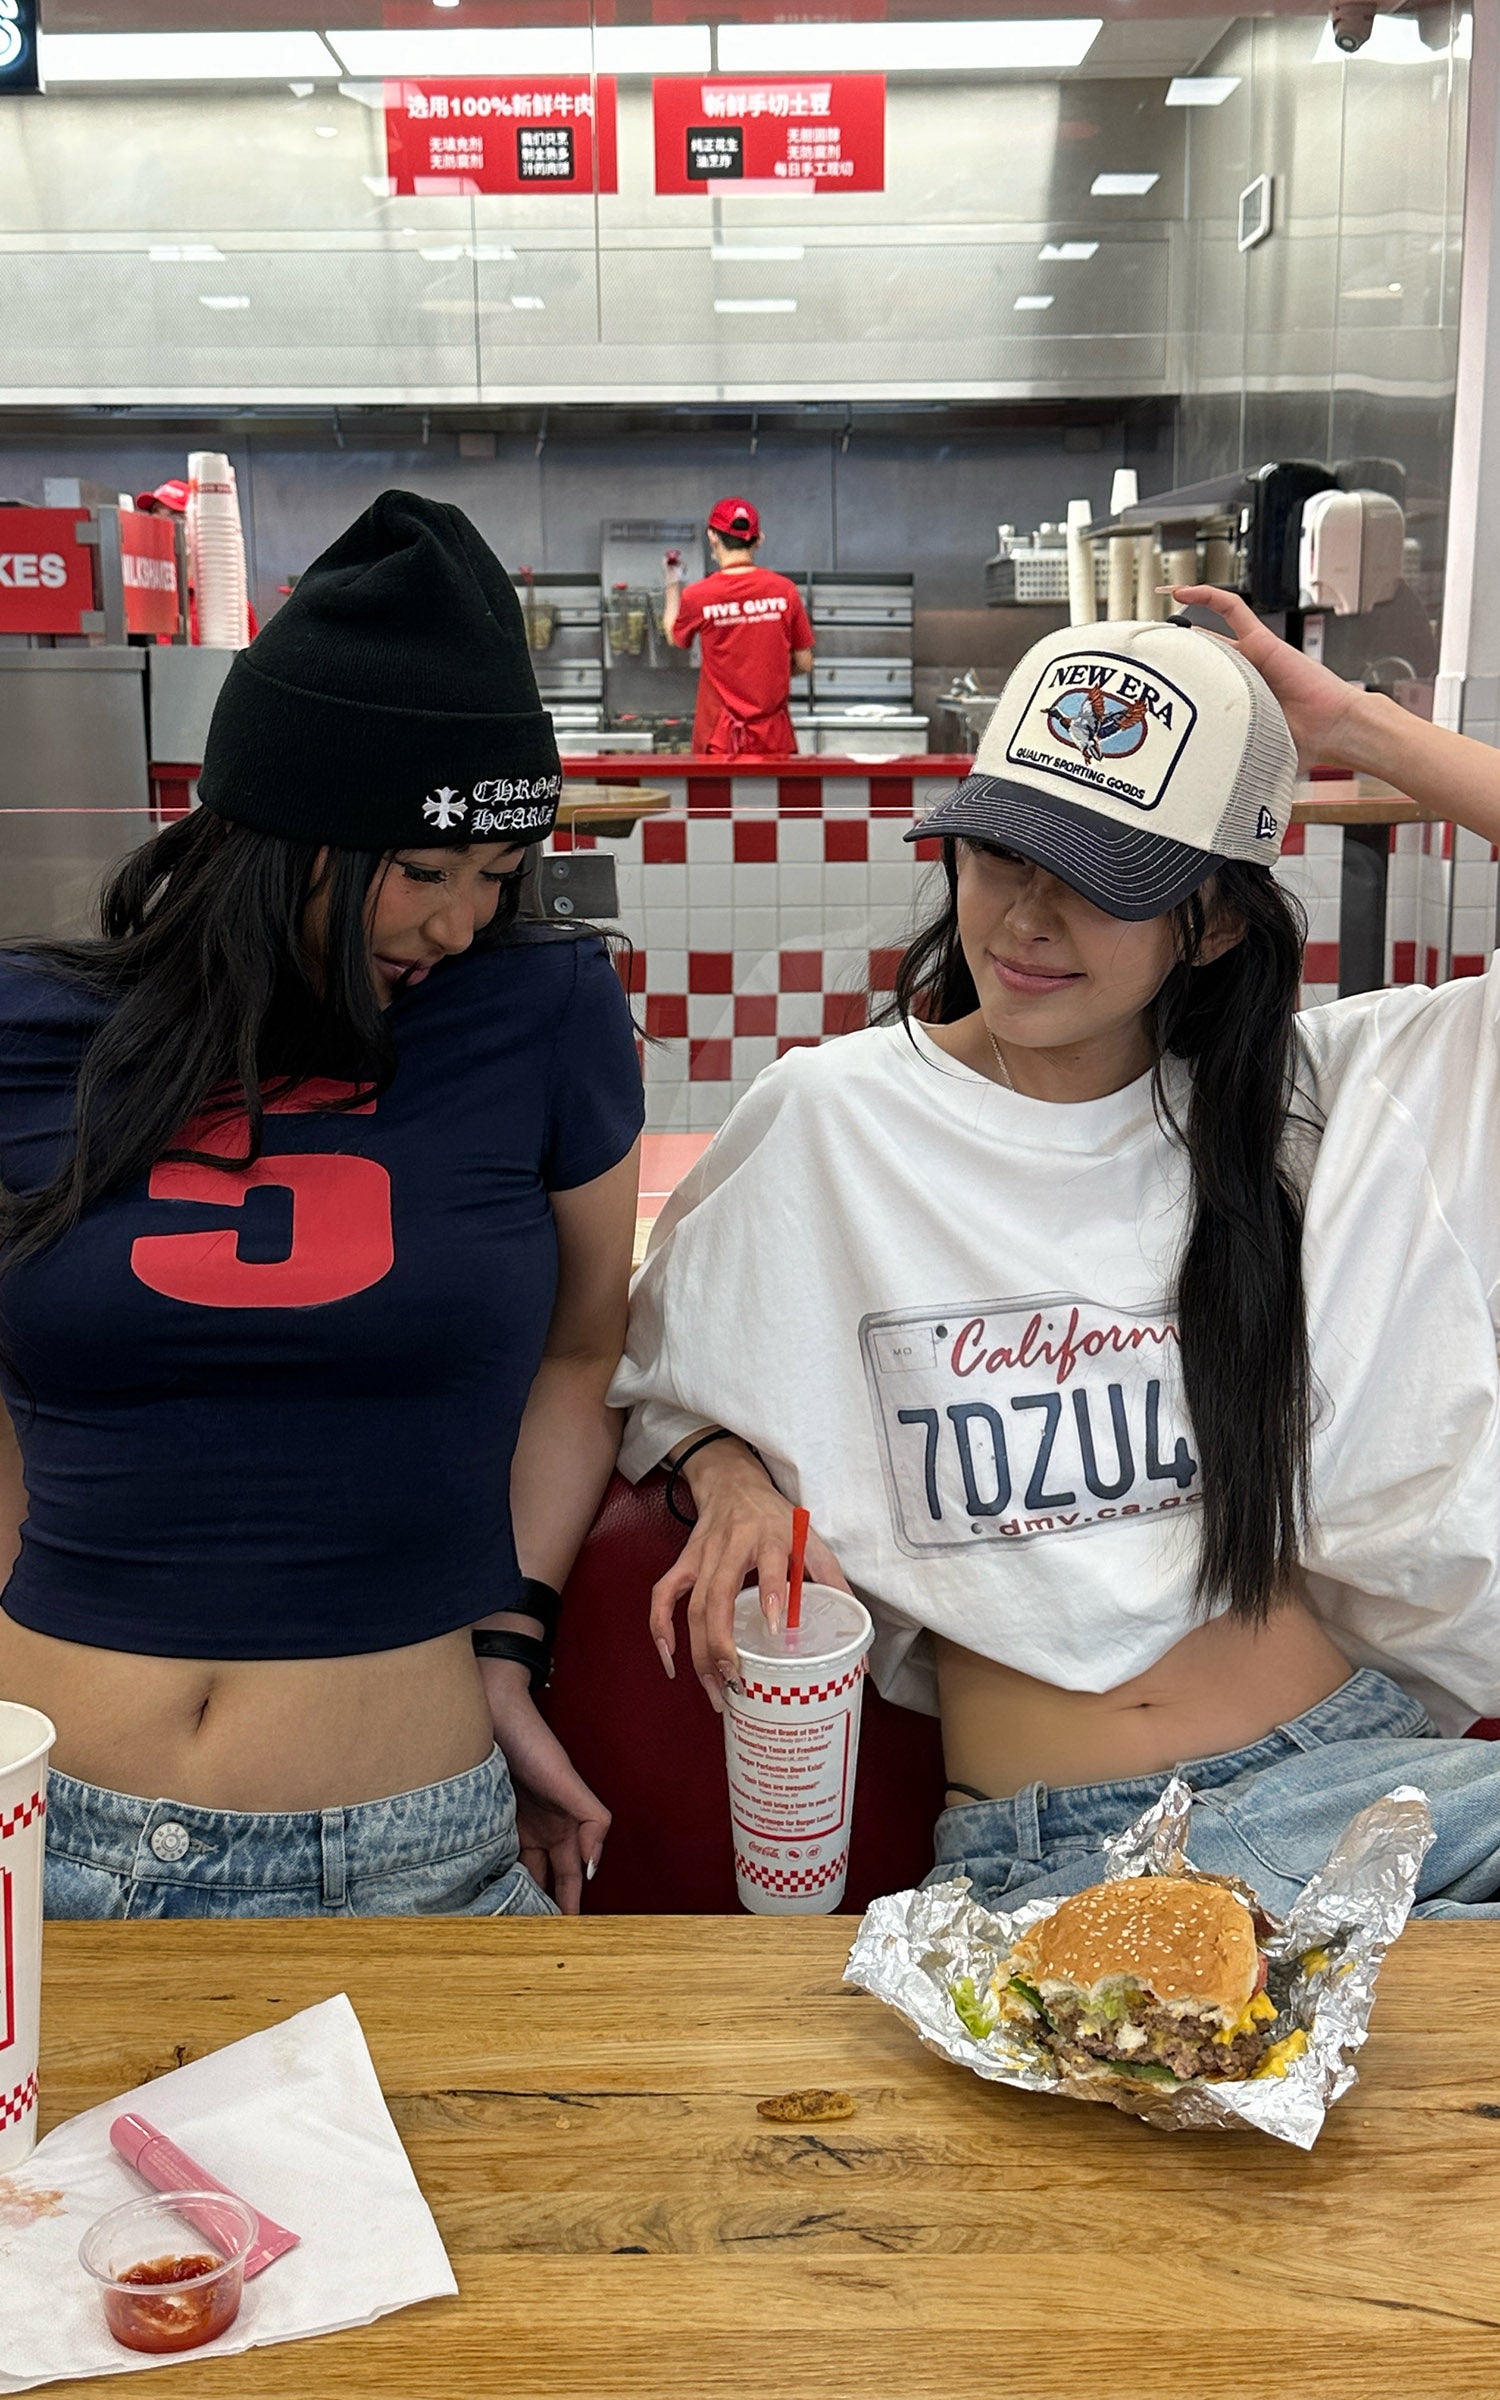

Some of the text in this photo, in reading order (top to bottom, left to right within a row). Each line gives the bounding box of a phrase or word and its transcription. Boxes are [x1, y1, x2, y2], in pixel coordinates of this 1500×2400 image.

[407, 93, 594, 119] 选用100%新鲜牛肉
[704, 93, 831, 118] 新鲜手切土豆
[702, 602, 741, 620] FIVE
[743, 597, 788, 616] GUYS
[1048, 664, 1174, 731] NEW ERA
[1015, 747, 1146, 801] QUALITY SPORTING GOODS
[130, 1075, 395, 1308] 5
